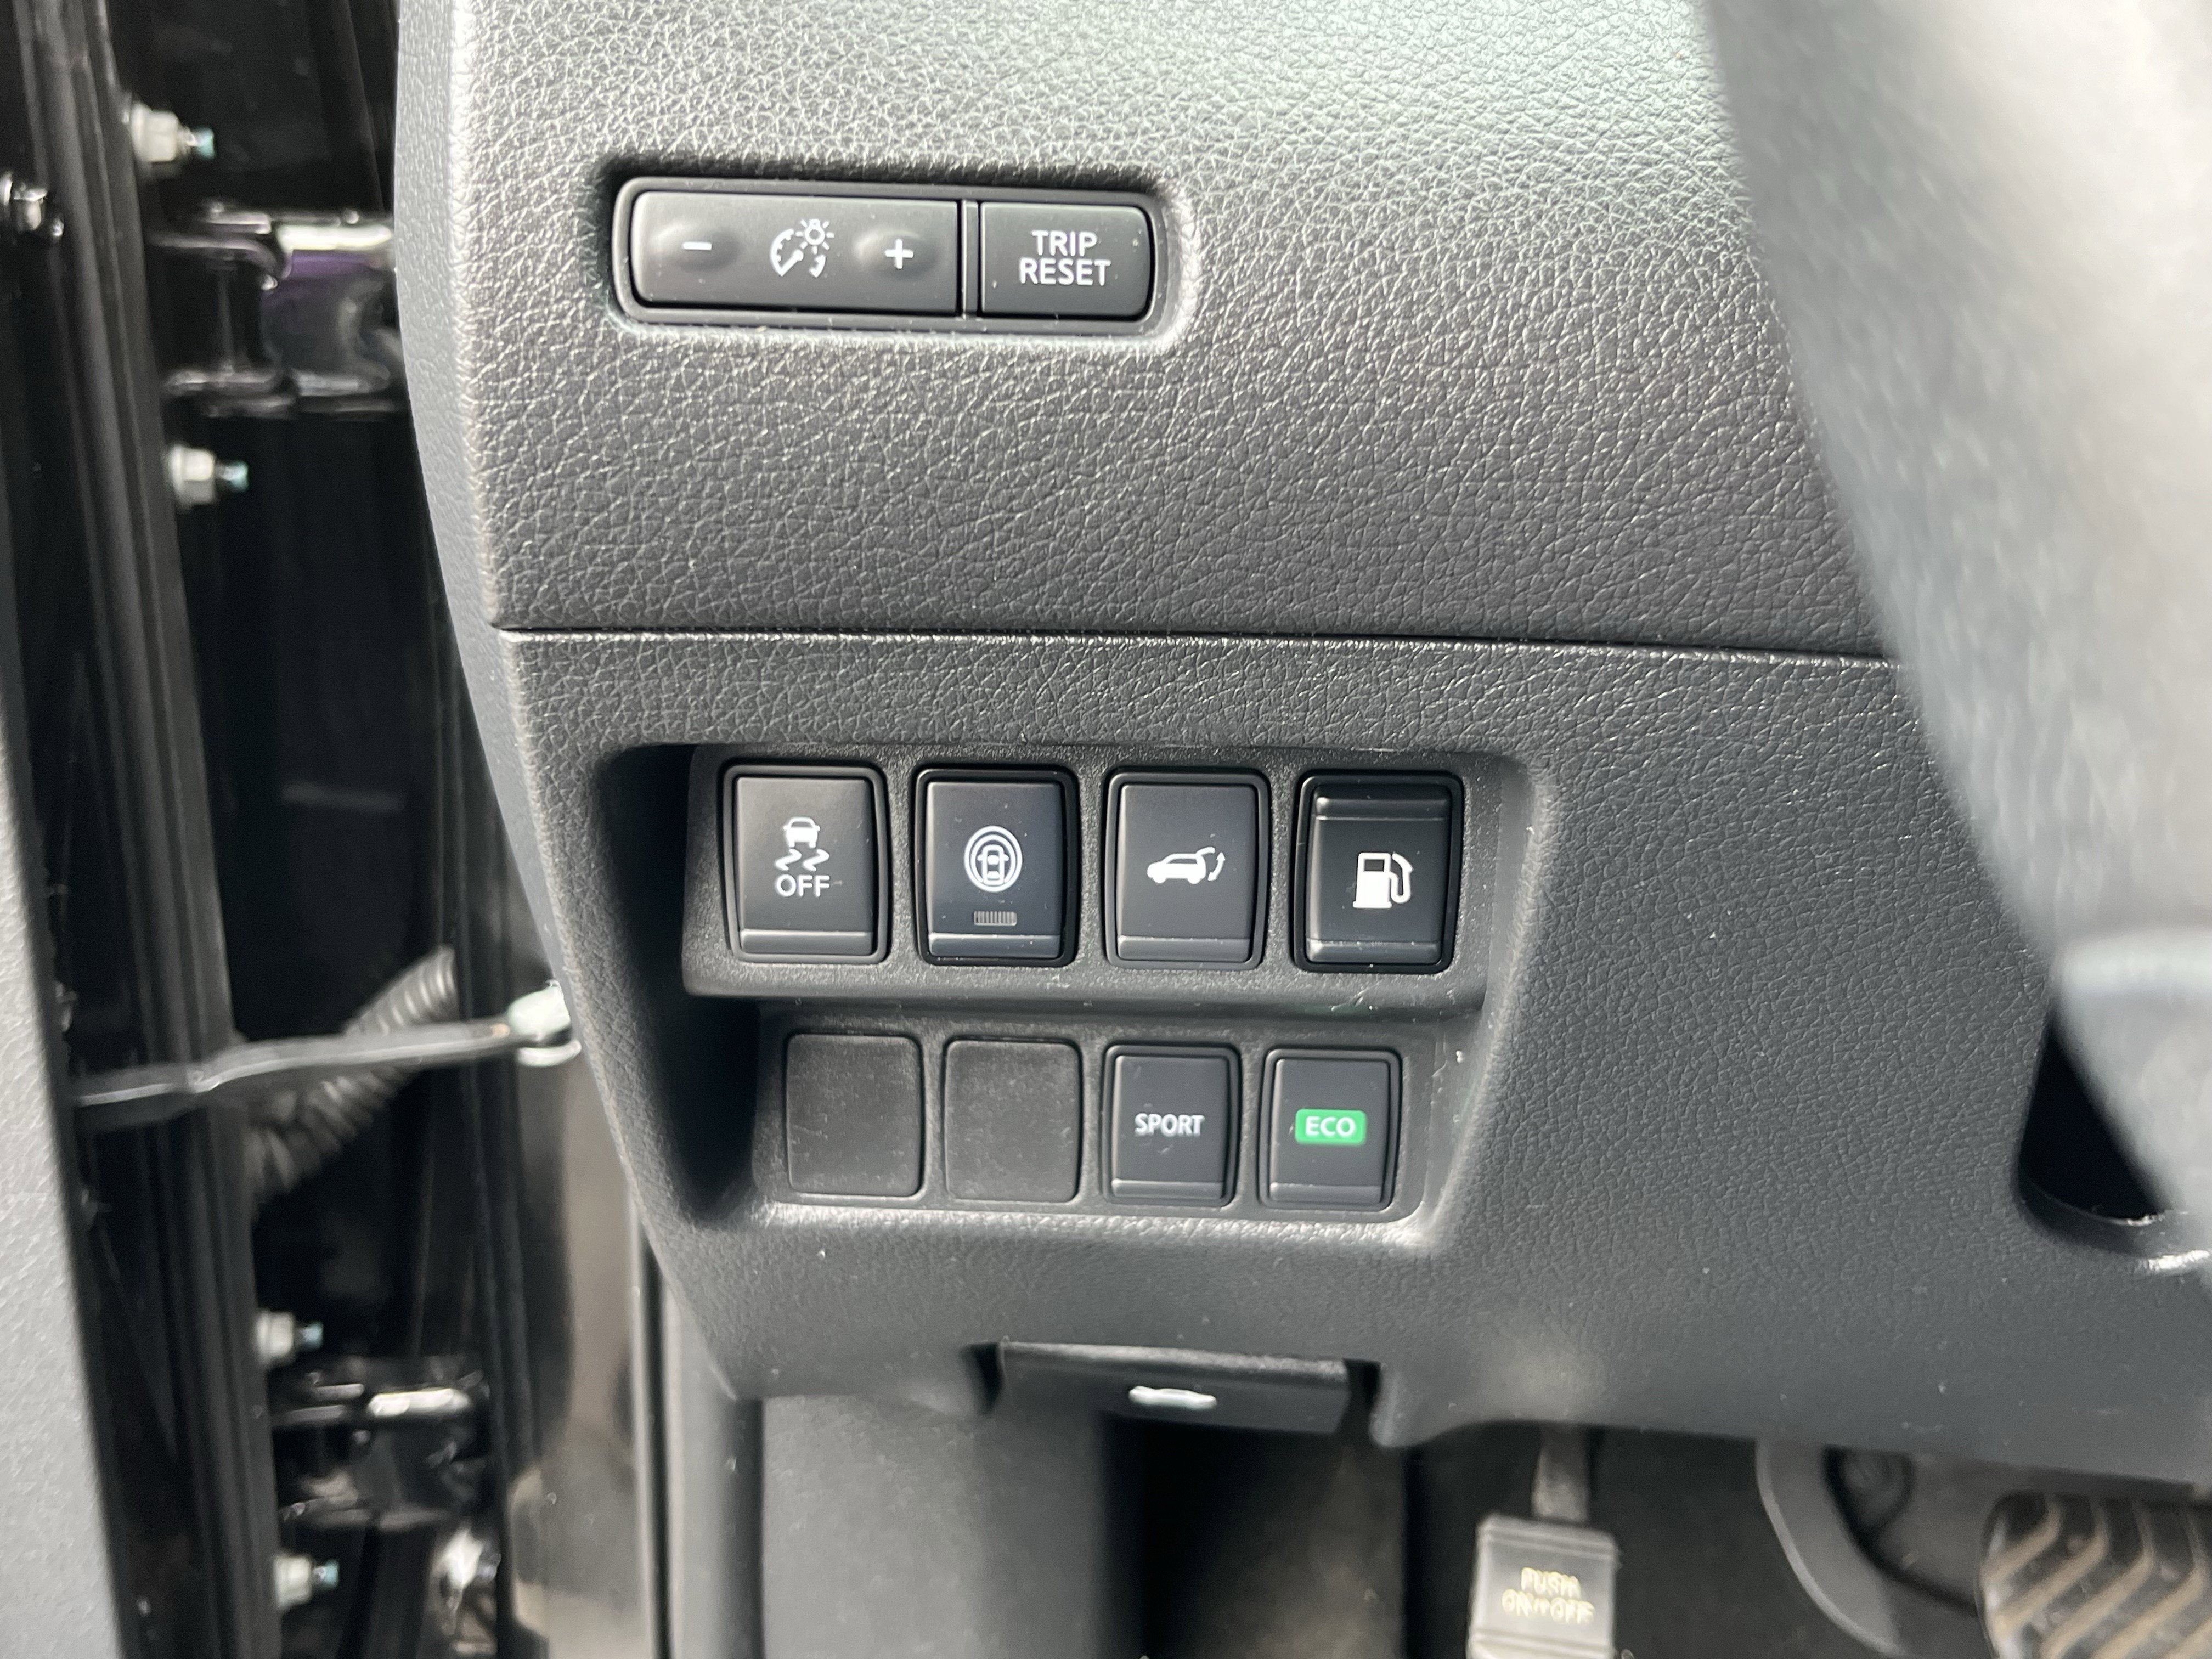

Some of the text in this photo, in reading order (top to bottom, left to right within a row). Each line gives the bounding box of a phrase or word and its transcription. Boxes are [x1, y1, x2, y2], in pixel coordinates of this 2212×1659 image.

[1032, 230, 1097, 256] TRIP
[1019, 256, 1111, 285] RESET
[776, 875, 830, 897] OFF
[1135, 1113, 1205, 1137] SPORT
[1306, 1117, 1356, 1137] ECO
[1521, 1567, 1581, 1599] PUSH
